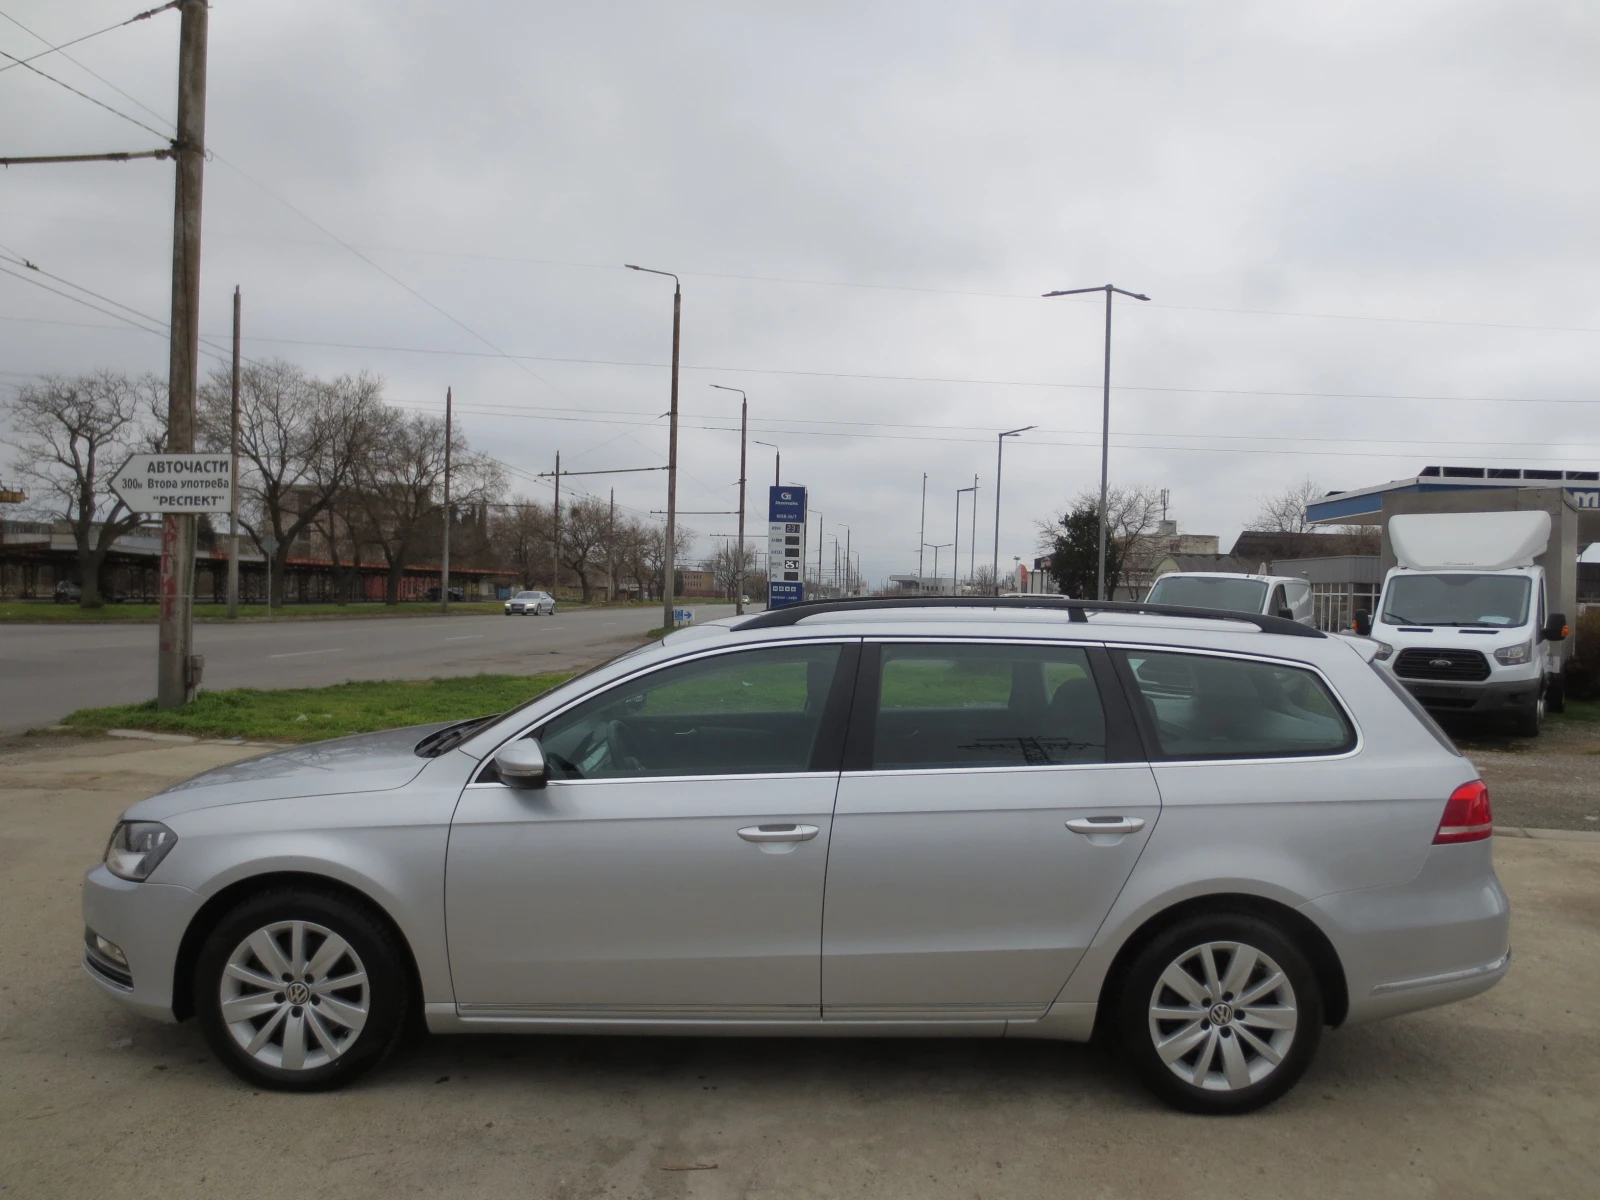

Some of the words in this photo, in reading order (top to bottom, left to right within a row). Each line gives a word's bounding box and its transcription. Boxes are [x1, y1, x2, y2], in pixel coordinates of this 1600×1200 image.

[147, 461, 229, 473] АВТОЧАСТИ
[147, 478, 178, 489] Втора
[181, 478, 229, 489] употреба
[153, 496, 224, 506] "РЕСПЕКТ"
